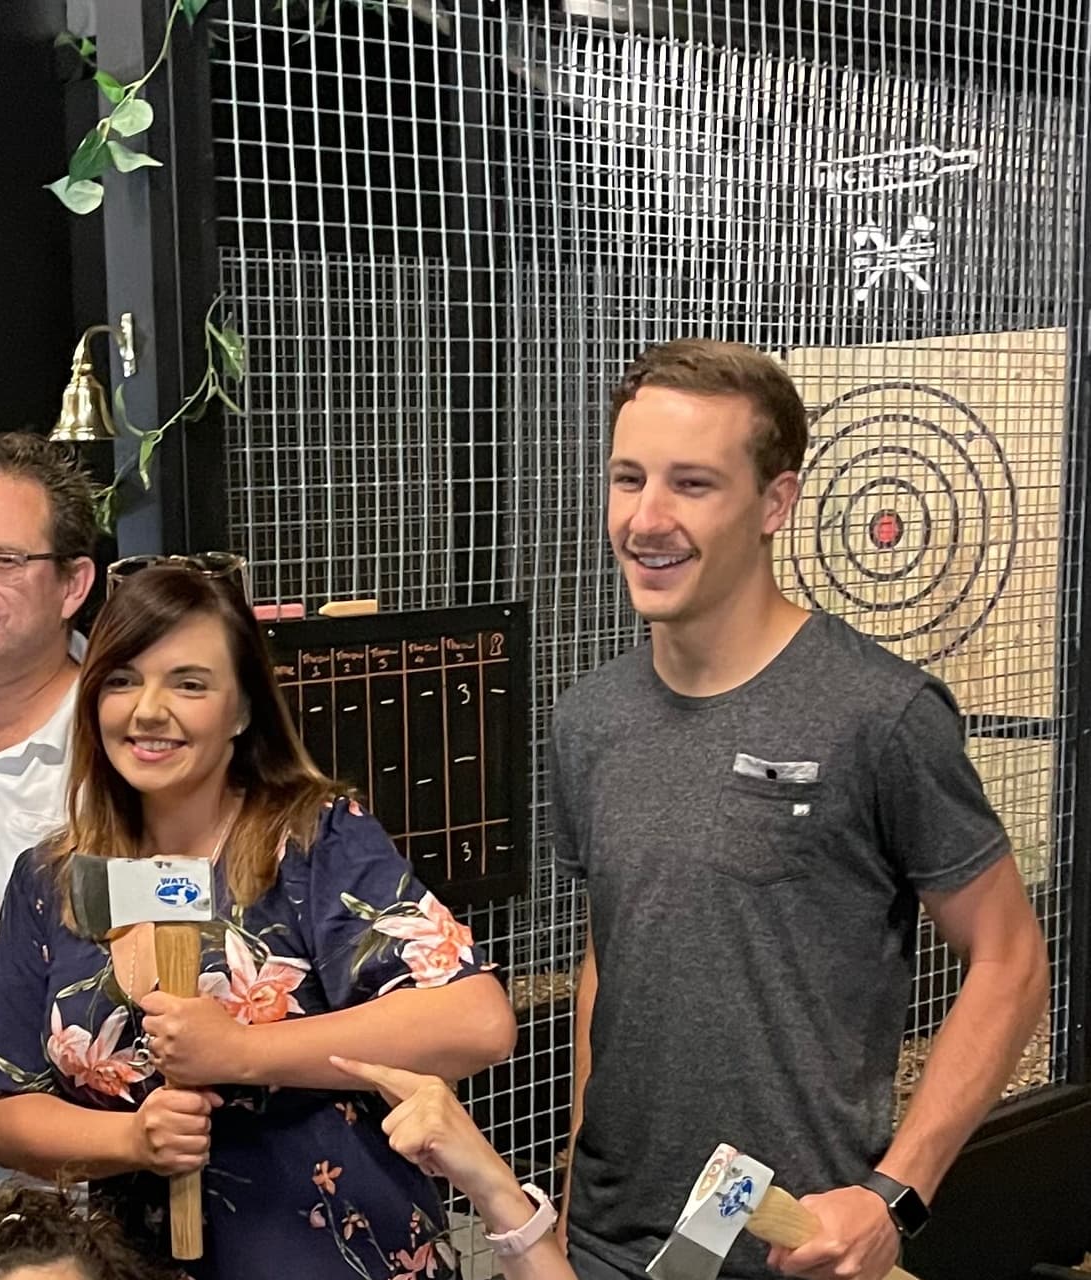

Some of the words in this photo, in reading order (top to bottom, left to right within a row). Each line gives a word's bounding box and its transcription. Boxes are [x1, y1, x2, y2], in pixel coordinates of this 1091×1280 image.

[456, 682, 472, 706] 3
[460, 841, 473, 862] 3
[160, 877, 193, 886] WATL
